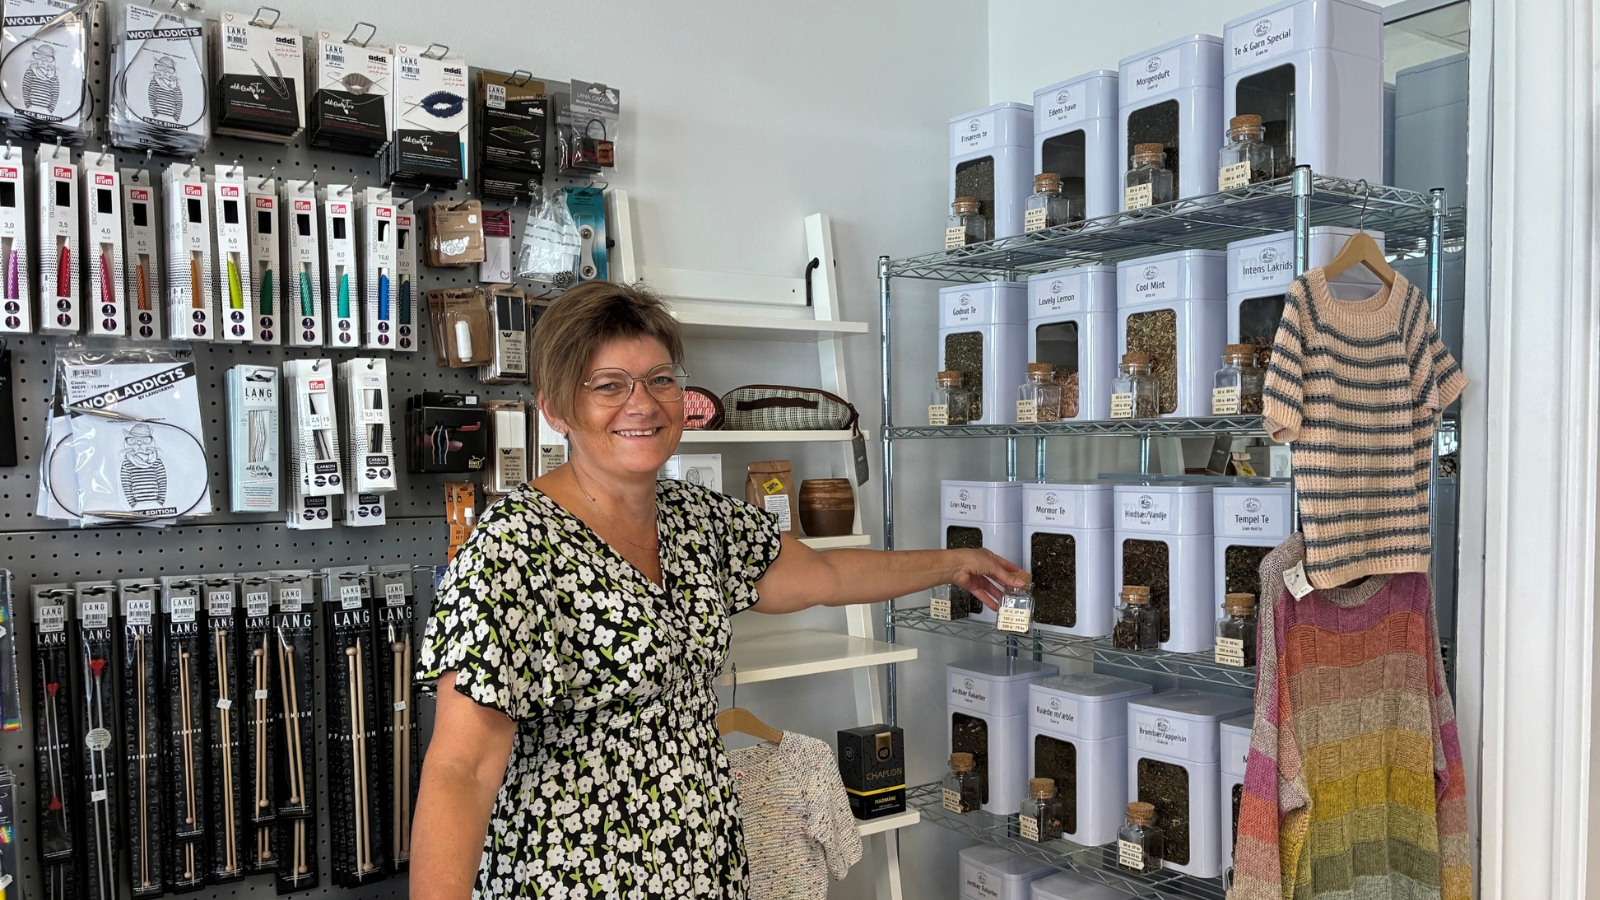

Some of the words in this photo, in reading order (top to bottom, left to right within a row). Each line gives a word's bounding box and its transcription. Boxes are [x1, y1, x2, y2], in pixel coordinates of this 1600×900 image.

[128, 28, 199, 39] WOOLADDICTS
[227, 26, 246, 35] LANG
[276, 37, 296, 45] addi
[1234, 47, 1241, 56] Te
[1243, 44, 1248, 53] &
[1250, 40, 1265, 50] Garn
[1267, 28, 1291, 45] Special
[325, 44, 343, 53] LANG
[368, 55, 387, 63] addi
[401, 56, 417, 65] LANG
[1136, 70, 1170, 86] Morgenduft
[489, 86, 504, 94] LANG
[1049, 108, 1063, 117] Edens
[1065, 104, 1076, 112] have
[55, 168, 71, 178] Prym
[96, 176, 112, 185] Prym
[132, 191, 147, 199] Prym
[186, 186, 201, 195] Prym
[223, 188, 238, 196] Prym
[377, 208, 391, 217] Prym
[1243, 266, 1265, 275] Intens
[1267, 260, 1293, 272] Lakrids
[1136, 283, 1148, 292] Cool
[1151, 281, 1165, 290] Mint
[1039, 296, 1055, 305] Lovely
[1057, 295, 1074, 303] Lemon
[77, 368, 185, 408] WOOLADDICTS
[246, 388, 272, 397] LANG
[1036, 506, 1058, 514] Mormor
[1059, 506, 1065, 515] Te
[1235, 514, 1259, 525] Tempel
[1261, 514, 1270, 524] Te
[334, 610, 369, 626] LANG
[379, 607, 412, 621] LANG
[208, 618, 234, 627] LANG
[246, 618, 269, 628] LANG
[273, 615, 311, 628] LANG
[125, 625, 153, 634] LANG
[170, 623, 198, 633] LANG
[38, 633, 66, 644] LANG
[82, 630, 111, 640] LANG
[1054, 711, 1074, 722] m/æble
[1139, 727, 1186, 742] Brombær/appelsin
[866, 767, 903, 780] CHAPLON
